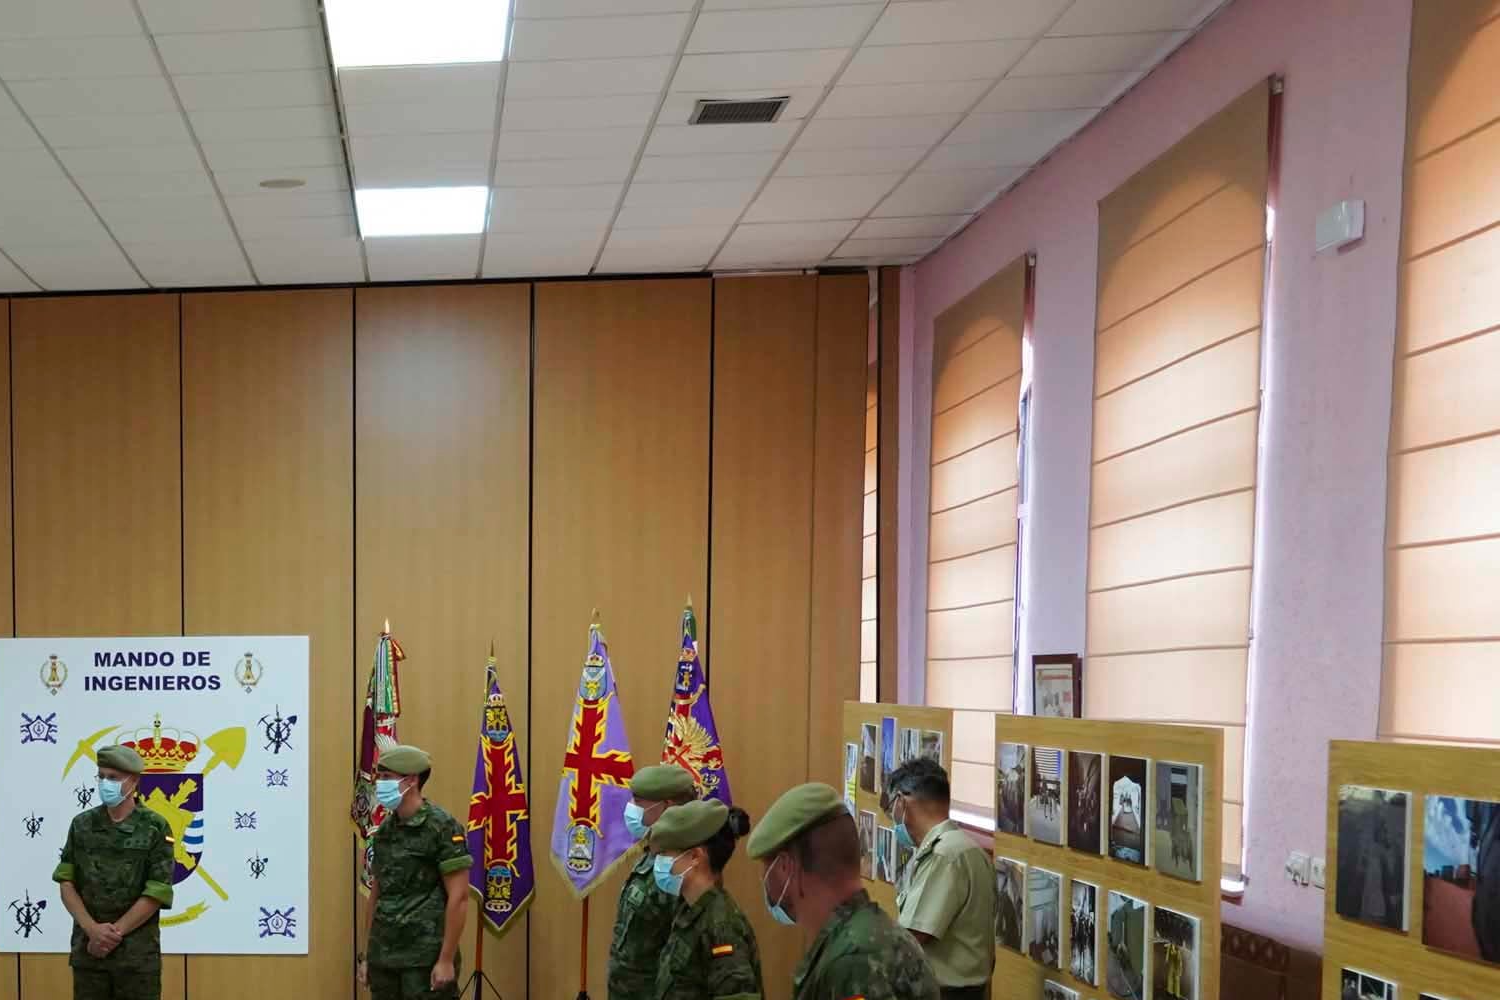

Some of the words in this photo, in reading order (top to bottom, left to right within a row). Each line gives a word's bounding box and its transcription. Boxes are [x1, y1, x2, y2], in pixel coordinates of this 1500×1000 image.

[94, 651, 175, 667] MANDO
[182, 651, 211, 667] DE
[84, 675, 221, 691] INGENIEROS
